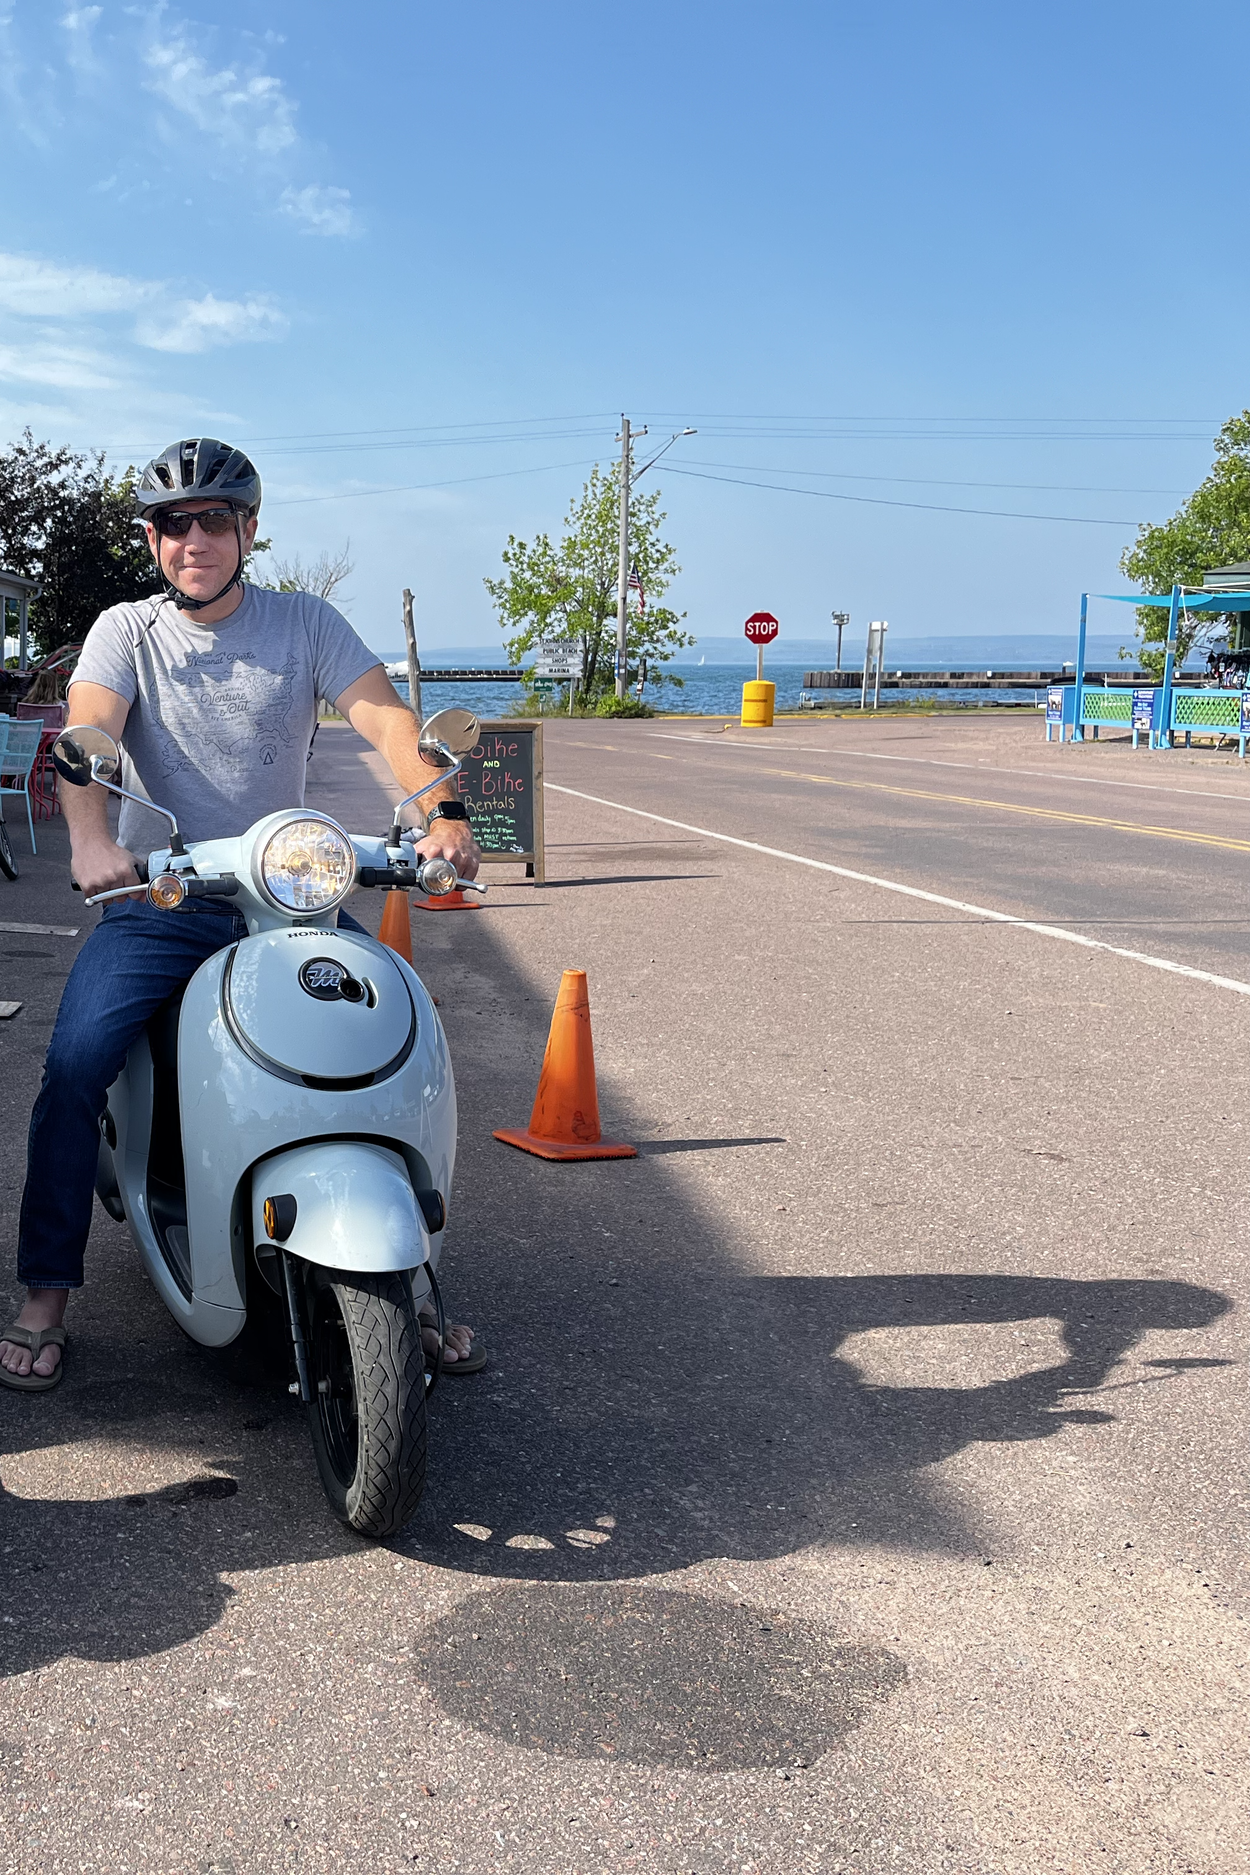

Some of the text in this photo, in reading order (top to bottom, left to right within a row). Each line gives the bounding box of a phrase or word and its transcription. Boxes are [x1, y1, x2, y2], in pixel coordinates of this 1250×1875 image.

[746, 622, 777, 635] STOP
[186, 651, 256, 667] National Parks
[200, 691, 248, 707] Venture
[227, 699, 252, 714] Out
[221, 713, 242, 722] AMERICA
[482, 760, 500, 768] AND
[464, 795, 515, 814] Rentals
